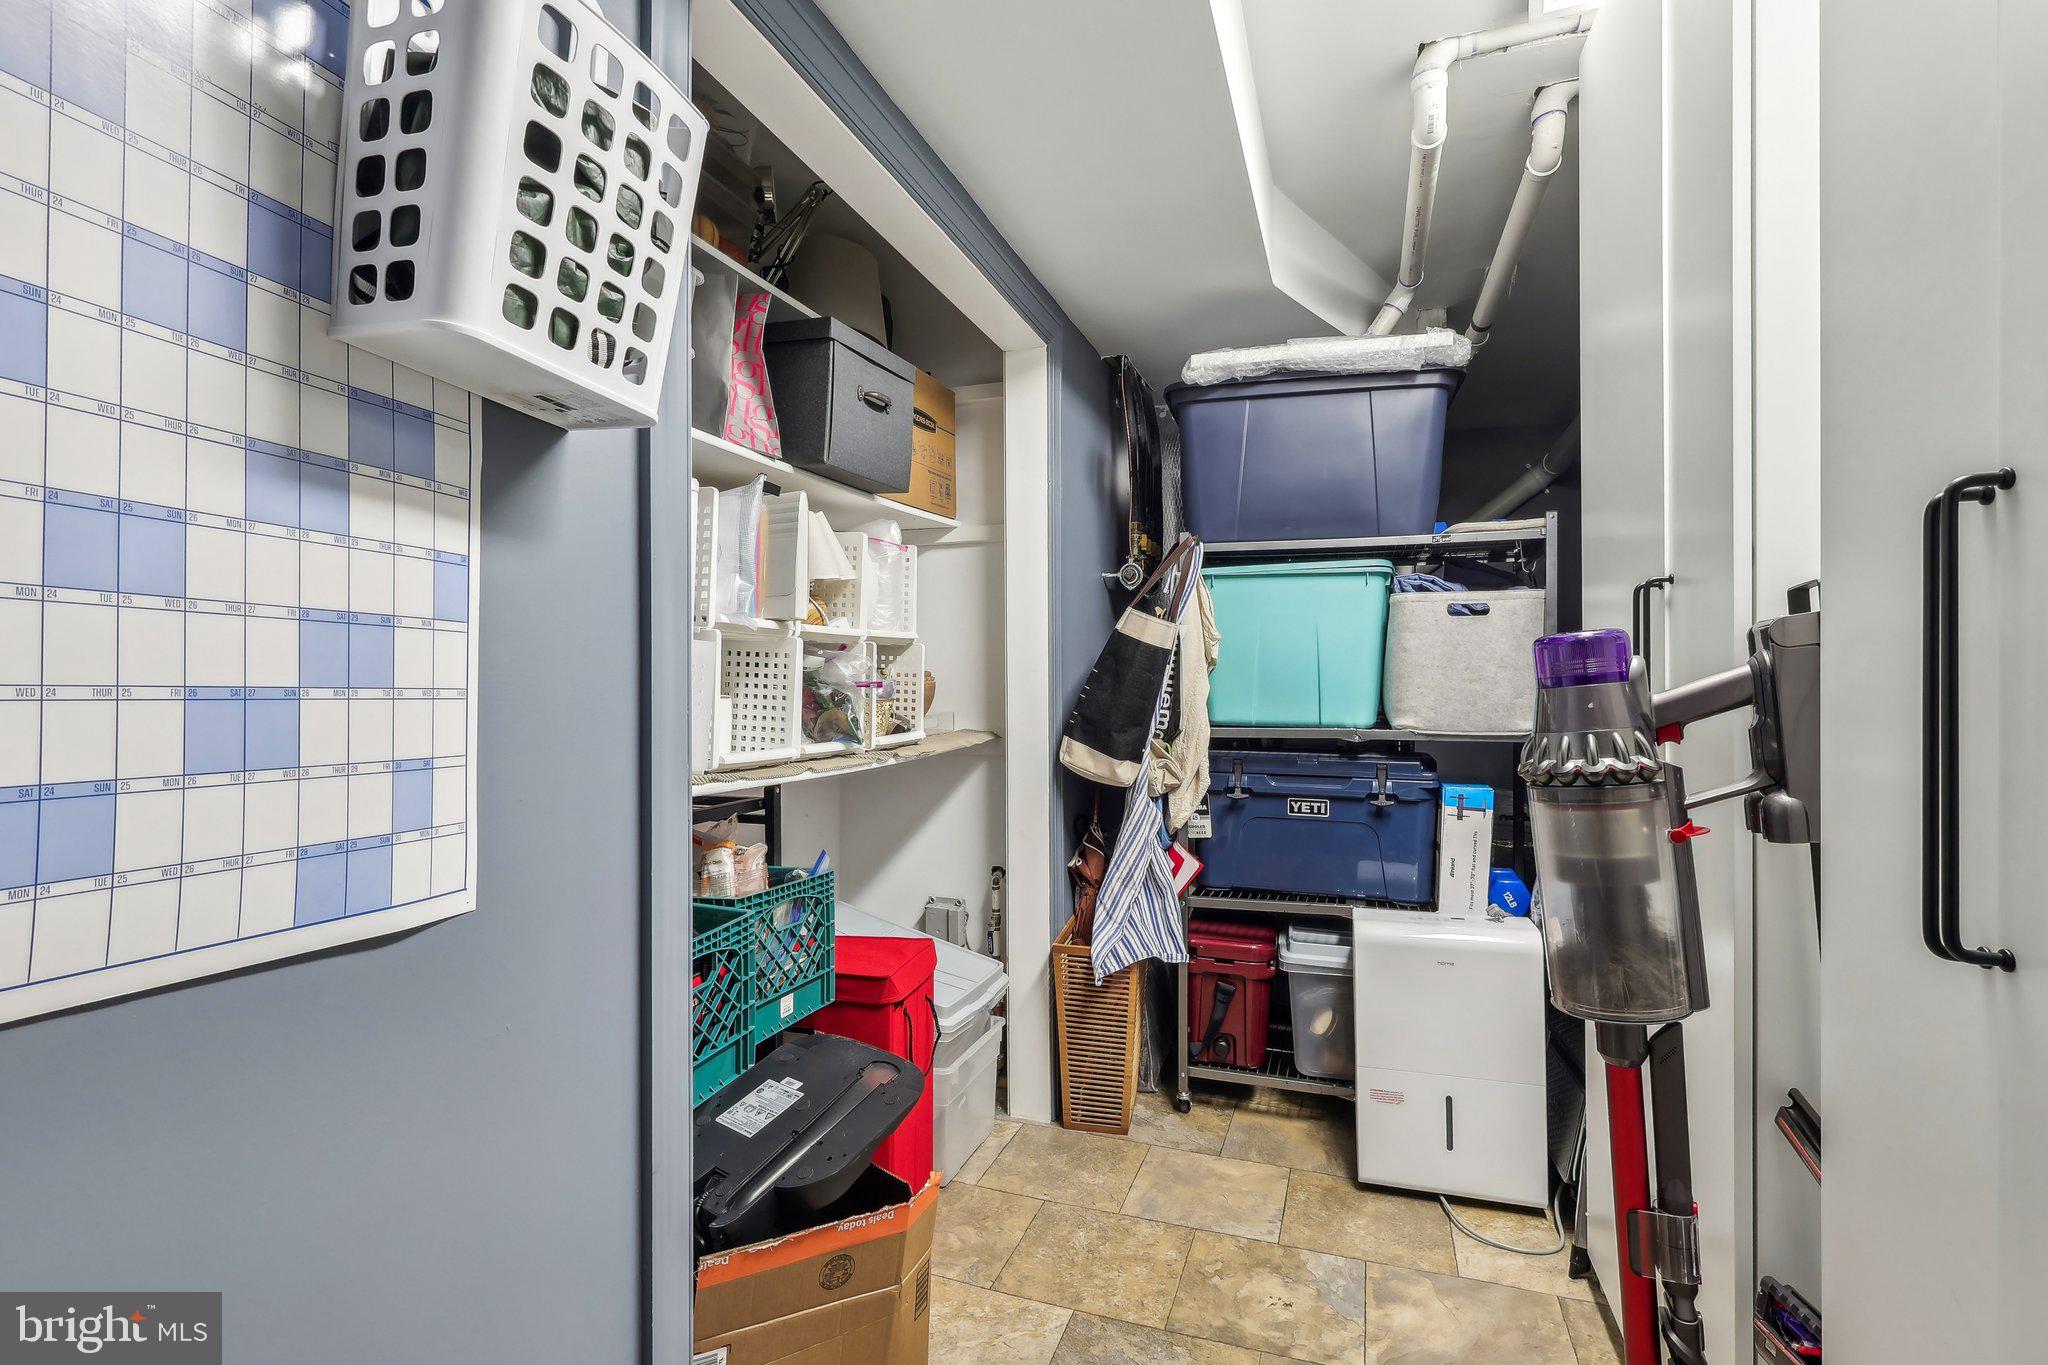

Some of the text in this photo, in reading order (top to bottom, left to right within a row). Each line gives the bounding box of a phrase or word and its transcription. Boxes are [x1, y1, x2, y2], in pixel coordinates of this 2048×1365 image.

[30, 87, 44, 101] TUE
[55, 98, 65, 111] 24
[102, 120, 120, 136] WED
[128, 133, 139, 145] 25
[169, 152, 187, 167] THUR
[193, 164, 203, 175] 26
[235, 184, 246, 196] FRI
[252, 192, 259, 201] 27
[236, 100, 247, 112] TUE
[253, 109, 261, 119] 27
[287, 127, 300, 141] WED
[305, 138, 313, 148] 28
[21, 183, 310, 305] THUR 24 FRI 25 SAT 26 SUN 27 MON 28
[23, 285, 41, 299] SUN
[51, 294, 62, 305] 24
[99, 308, 117, 322] MON
[125, 317, 135, 328] 25
[172, 332, 183, 343] TUE
[190, 338, 199, 348] 26
[228, 350, 243, 362] WED
[249, 357, 257, 366] 27
[281, 367, 297, 378] THUR
[302, 373, 309, 382] 28
[337, 384, 346, 393] FRI
[25, 386, 40, 398] TUE
[50, 392, 60, 403] 24
[97, 403, 115, 415] WED
[124, 410, 135, 420] 25
[164, 419, 182, 432] THUR
[189, 425, 198, 435] 26
[232, 435, 242, 445] FRI
[248, 440, 256, 448] 27
[286, 448, 297, 457] SAT
[302, 451, 310, 461] 28
[351, 463, 359, 472] 29
[379, 470, 391, 479] MON
[25, 487, 39, 497] FRI
[49, 490, 58, 501] 24
[100, 499, 113, 509] SAT
[123, 502, 133, 512] 25
[167, 509, 182, 519] SUN
[189, 513, 198, 522] 26
[226, 519, 242, 529] MON
[248, 522, 256, 530] 27
[286, 528, 296, 537] TUE
[302, 530, 310, 539] 28
[351, 537, 359, 547] 29
[16, 586, 37, 597] MON
[47, 589, 57, 599] 24
[99, 593, 112, 603] TUE
[122, 595, 133, 605] 25
[164, 598, 181, 608] WED
[188, 600, 198, 610] 26
[225, 603, 242, 613] THUR
[248, 605, 256, 615] 27
[287, 608, 296, 617] FRI
[302, 609, 310, 618] 28
[336, 612, 346, 621] SAT
[351, 613, 359, 622] 29
[381, 616, 391, 625] SUN
[16, 688, 36, 697] WED
[46, 688, 56, 697] 24
[92, 688, 112, 697] THUR
[122, 688, 132, 697] 25
[170, 688, 181, 697] FRI
[188, 688, 198, 697] 26
[230, 688, 242, 697] SAT
[248, 688, 256, 697] 27
[283, 689, 297, 697] SUN
[302, 689, 310, 697] 28
[351, 689, 359, 697] 29
[382, 689, 391, 697] TUE
[18, 788, 34, 798] SAT
[44, 787, 55, 796] 24
[94, 782, 111, 793] SUN
[120, 781, 131, 791] 25
[162, 778, 180, 788] MON
[187, 776, 196, 786] 26
[230, 773, 241, 782] TUE
[248, 772, 255, 781] 27
[283, 769, 296, 778] WED
[301, 768, 309, 777] 28
[332, 765, 346, 775] THUR
[351, 764, 358, 773] 29
[383, 763, 391, 771] FRI
[1291, 802, 1326, 814] YETI
[8, 888, 30, 901] MON
[40, 885, 50, 896] 24
[94, 878, 107, 888] TUE
[117, 874, 128, 884] 25
[161, 867, 178, 877] WED
[184, 865, 194, 874] 26
[222, 858, 239, 869] THUR
[246, 856, 254, 865] 27
[286, 849, 295, 859] FRI
[300, 848, 308, 857] 28
[335, 842, 345, 852] SAT
[350, 840, 357, 849] 29
[380, 836, 390, 845] SUN
[1503, 892, 1517, 908] 12LB
[869, 1211, 894, 1225] Deals
